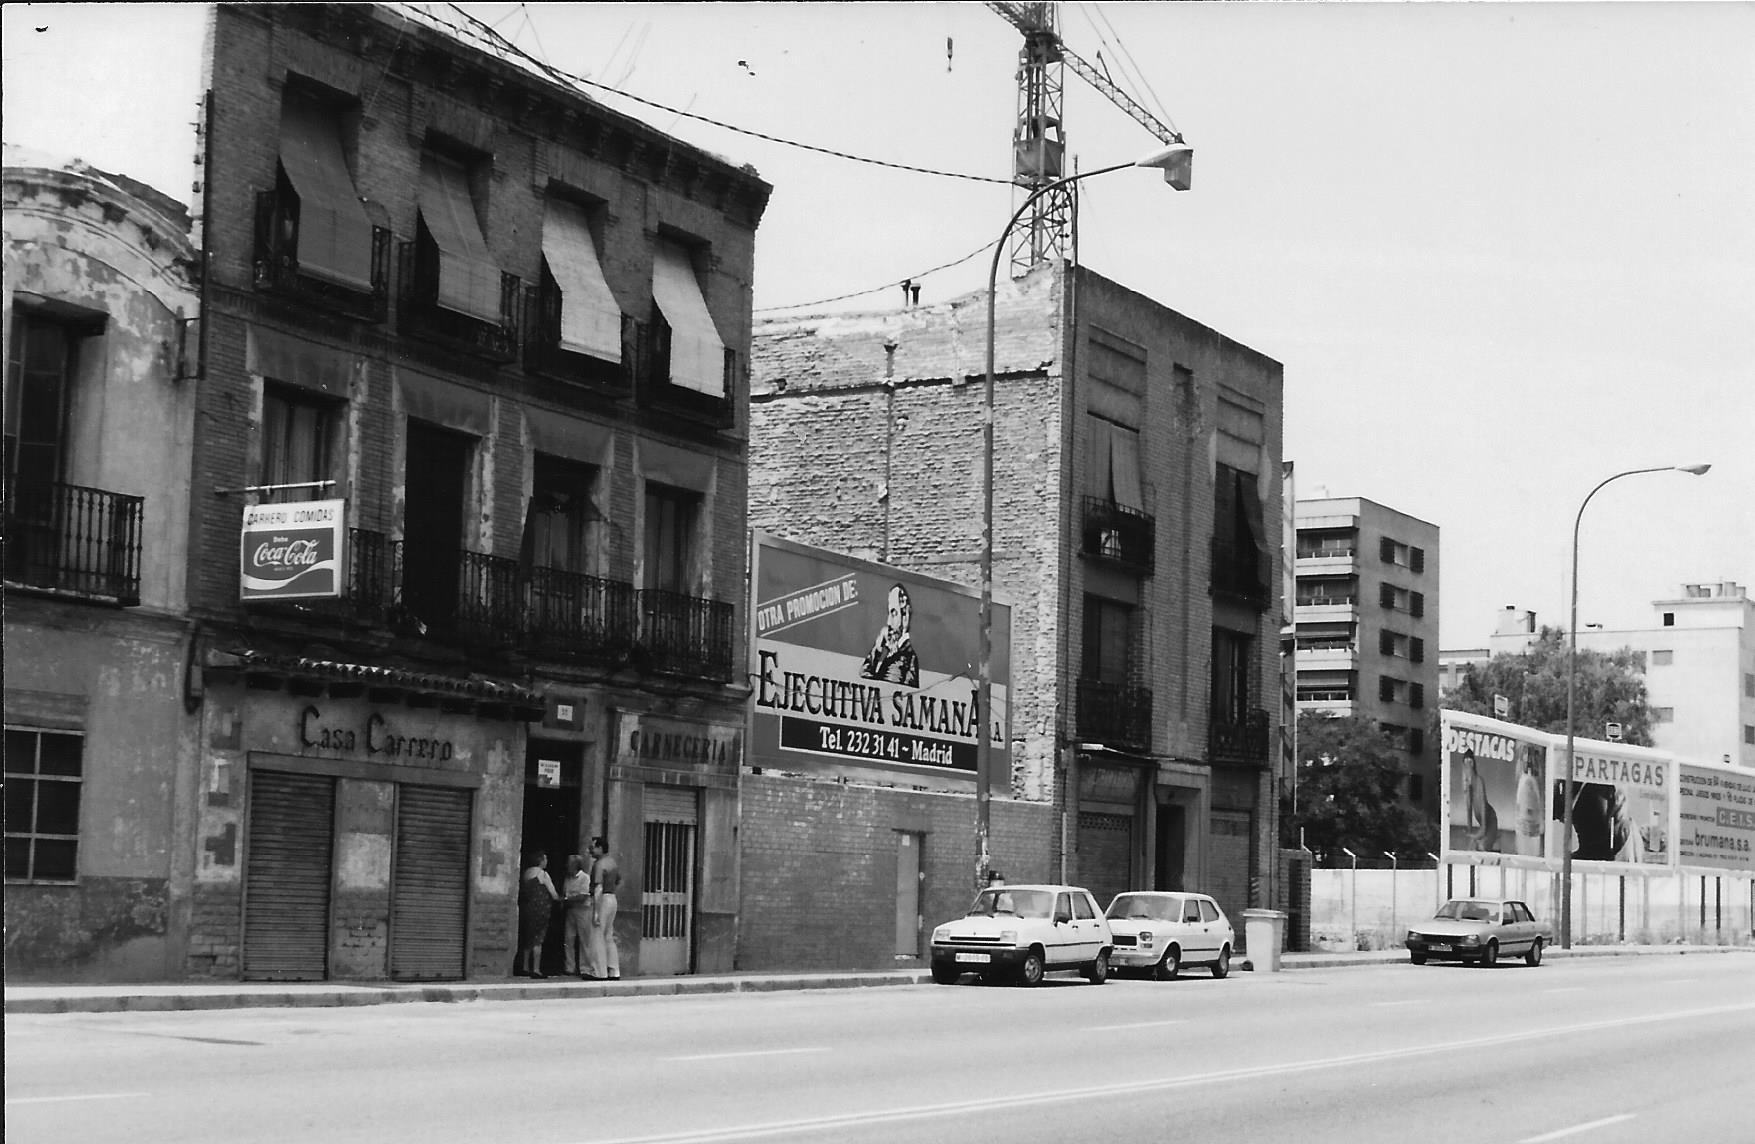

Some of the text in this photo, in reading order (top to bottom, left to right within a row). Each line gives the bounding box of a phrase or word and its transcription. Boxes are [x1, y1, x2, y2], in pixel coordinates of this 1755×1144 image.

[293, 509, 335, 523] COMIDAS
[758, 604, 784, 631] OTRA
[786, 584, 841, 621] PROMOCION
[756, 650, 885, 725] EJECUTIVA
[301, 705, 356, 751] Casa
[1447, 728, 1515, 762] DESTACAS
[630, 730, 728, 765] CARNECERIA
[846, 730, 870, 755] 232
[871, 734, 885, 756] 31
[887, 737, 899, 758] 41
[911, 739, 953, 765] Madrid
[1574, 756, 1664, 787] PARTAGAS
